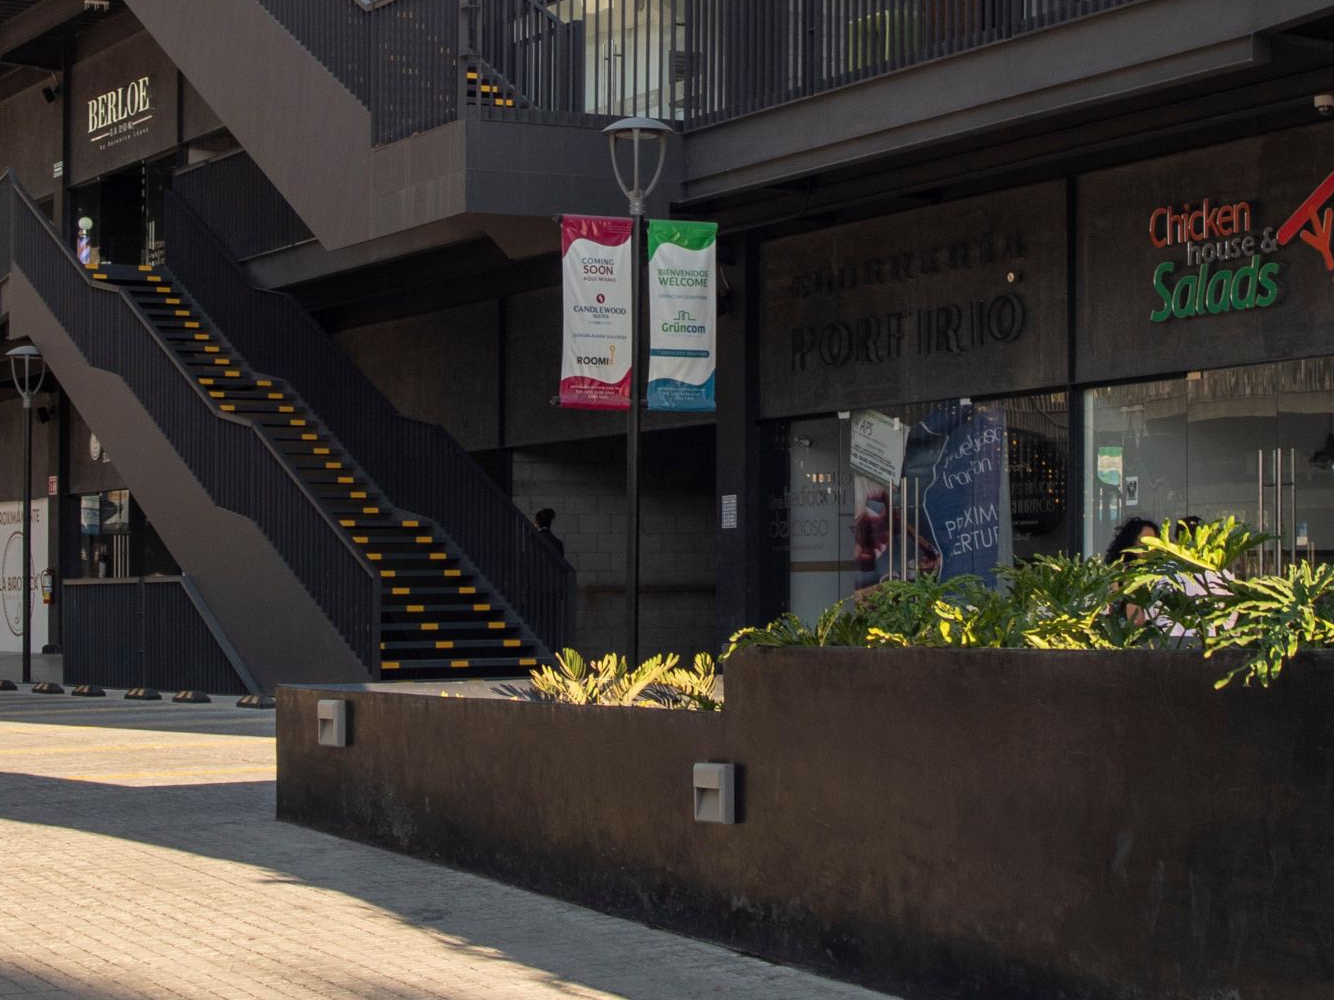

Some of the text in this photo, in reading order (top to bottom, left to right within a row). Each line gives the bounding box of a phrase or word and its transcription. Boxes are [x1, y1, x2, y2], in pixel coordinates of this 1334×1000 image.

[87, 76, 150, 134] BERLOE
[1149, 198, 1250, 249] Chicken
[1187, 227, 1279, 266] house &
[581, 258, 615, 266] COMING
[583, 265, 614, 275] SOON
[658, 268, 708, 277] BIENVENIDOS
[658, 277, 708, 288] WELCOME
[1150, 254, 1280, 322] Salads
[573, 305, 626, 315] CANDLEWOOD
[661, 322, 706, 334] Grüncom
[791, 294, 1025, 370] PORFIRIO
